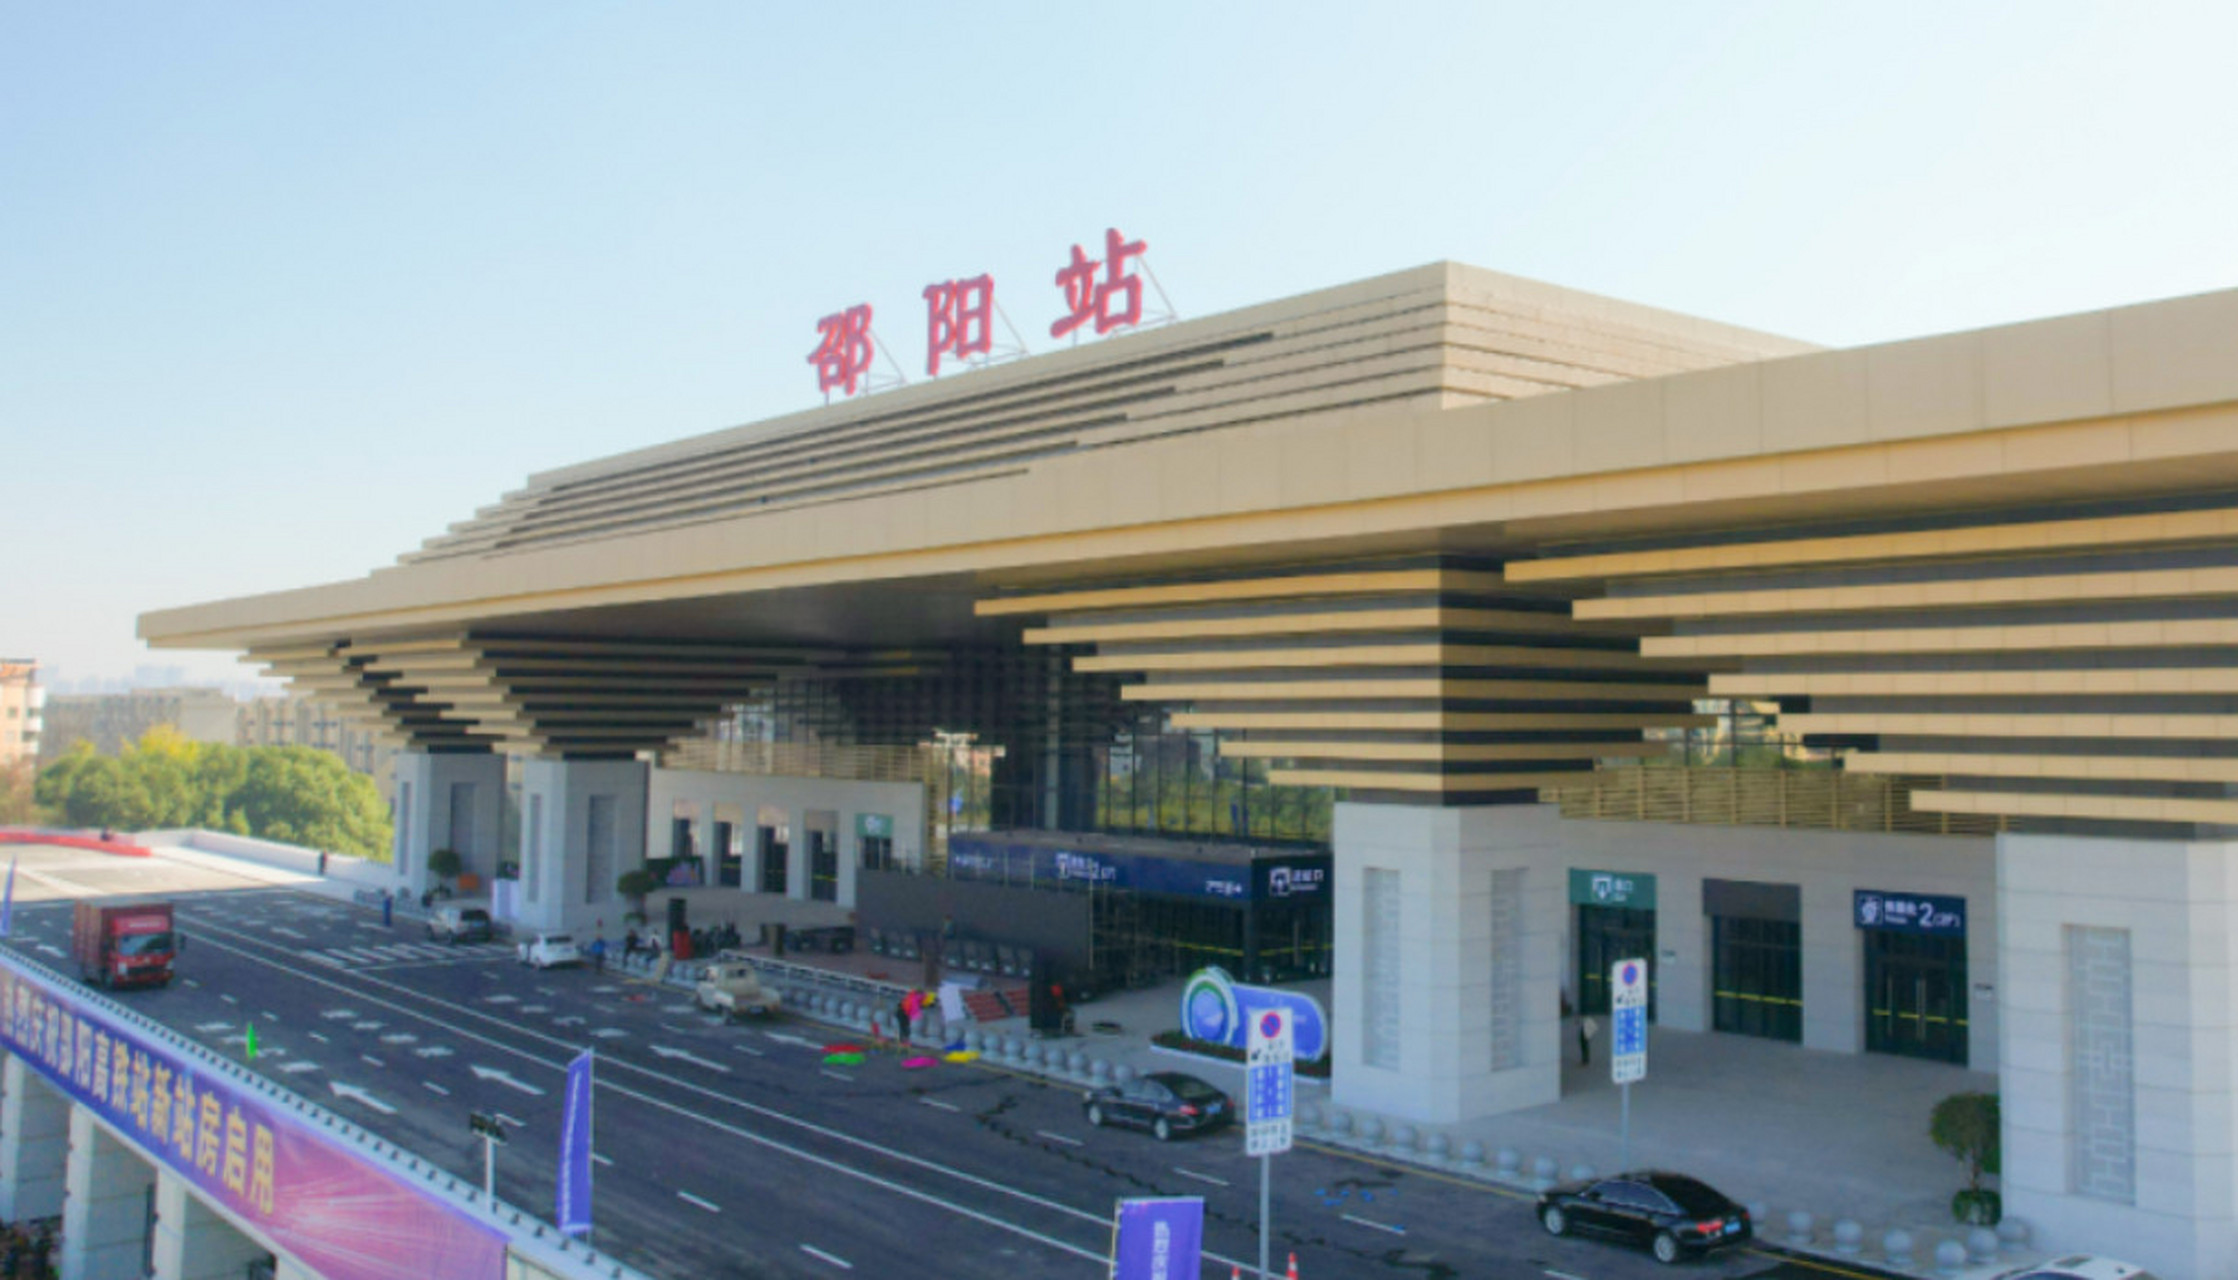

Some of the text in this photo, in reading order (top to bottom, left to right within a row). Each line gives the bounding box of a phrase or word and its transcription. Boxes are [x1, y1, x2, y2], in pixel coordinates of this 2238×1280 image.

[806, 227, 1147, 396] 邵阳站
[1919, 901, 1934, 928] 2
